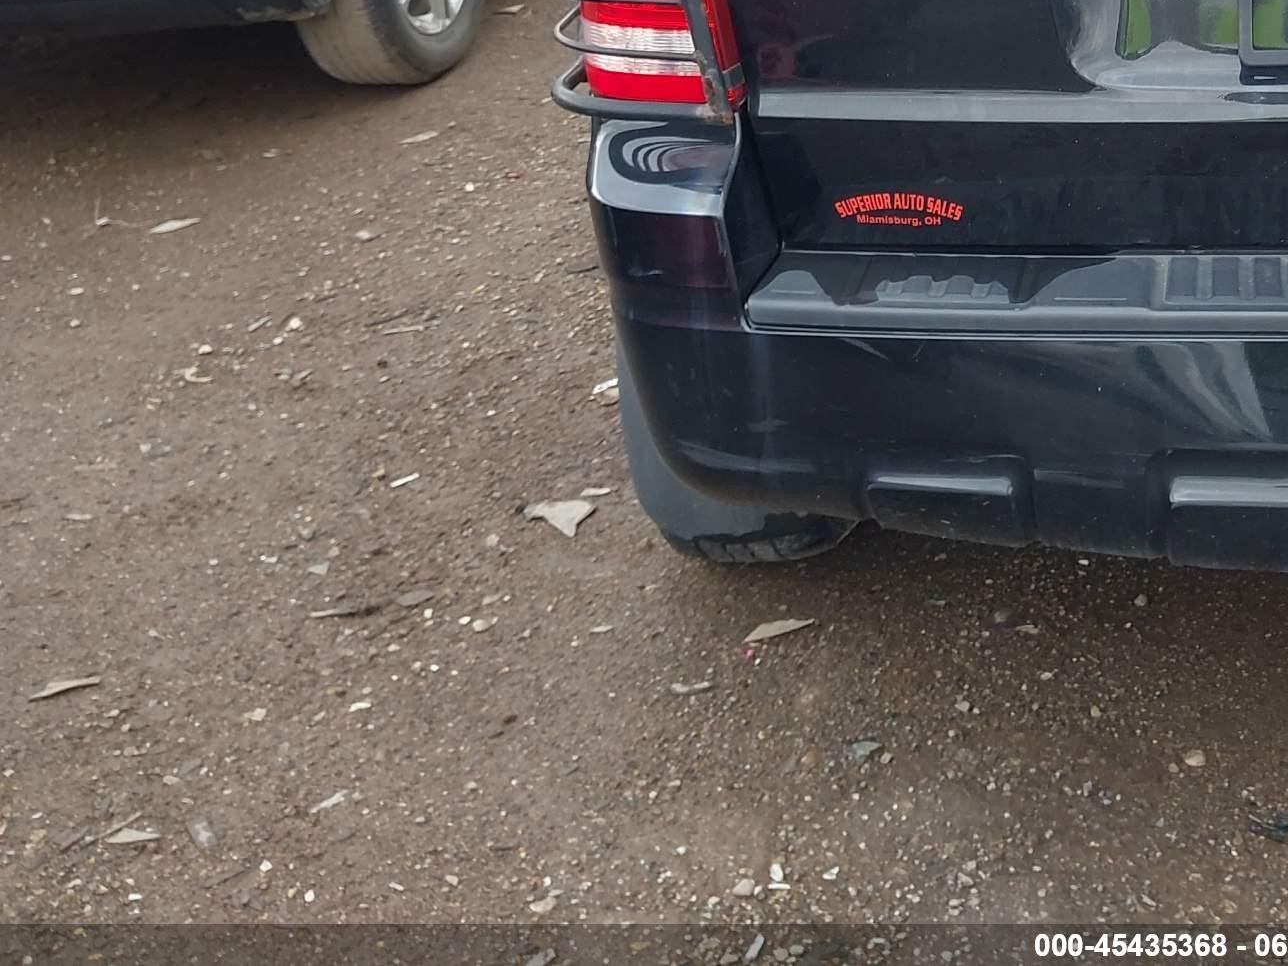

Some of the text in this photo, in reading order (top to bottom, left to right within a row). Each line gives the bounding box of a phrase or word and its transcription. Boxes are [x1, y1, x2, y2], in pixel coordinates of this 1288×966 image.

[834, 192, 964, 222] SUPERIOR AUTO SALES
[856, 214, 942, 227] Miamisburg, OH
